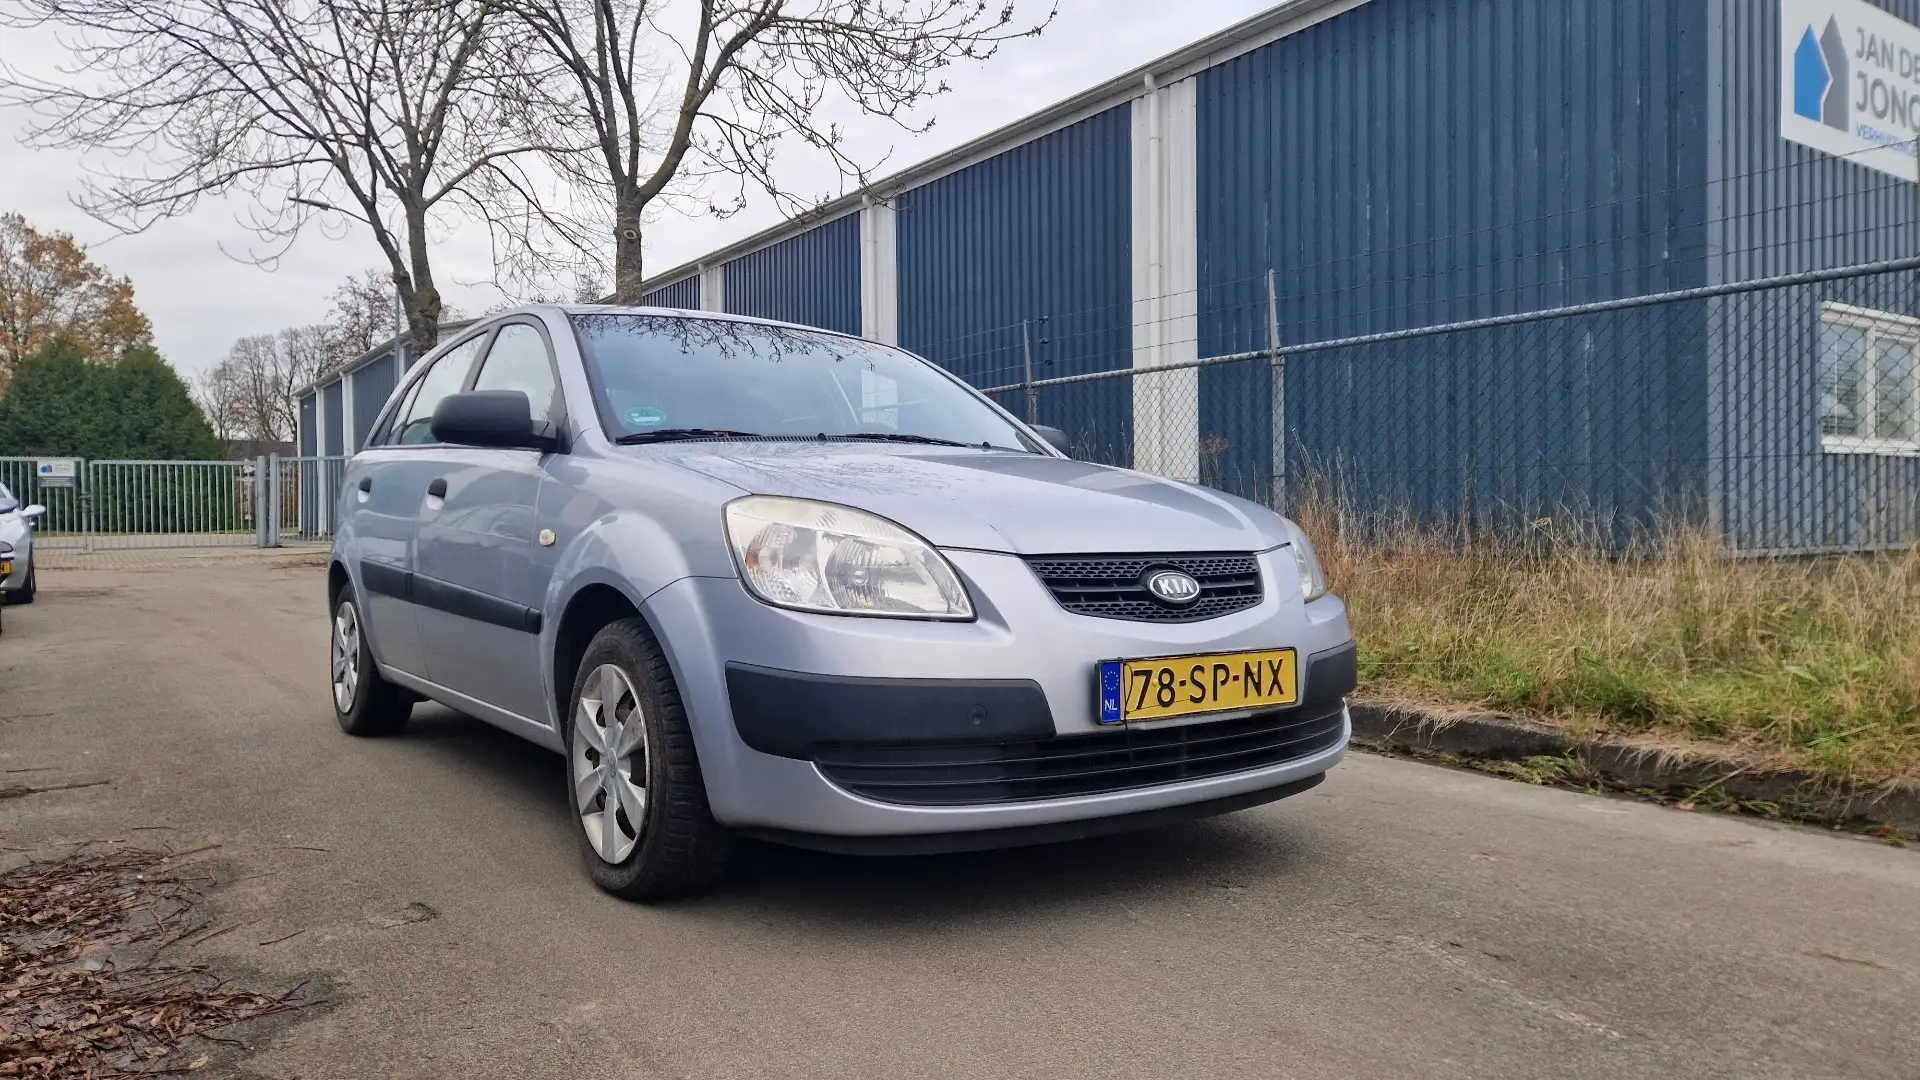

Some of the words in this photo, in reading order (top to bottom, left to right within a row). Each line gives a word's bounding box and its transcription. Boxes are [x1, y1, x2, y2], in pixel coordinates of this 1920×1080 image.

[1855, 26, 1895, 73] JAN
[1900, 46, 1920, 84] DE
[1157, 578, 1195, 595] KIA
[1133, 658, 1285, 711] 78-SP-NX
[1104, 698, 1118, 712] NL
